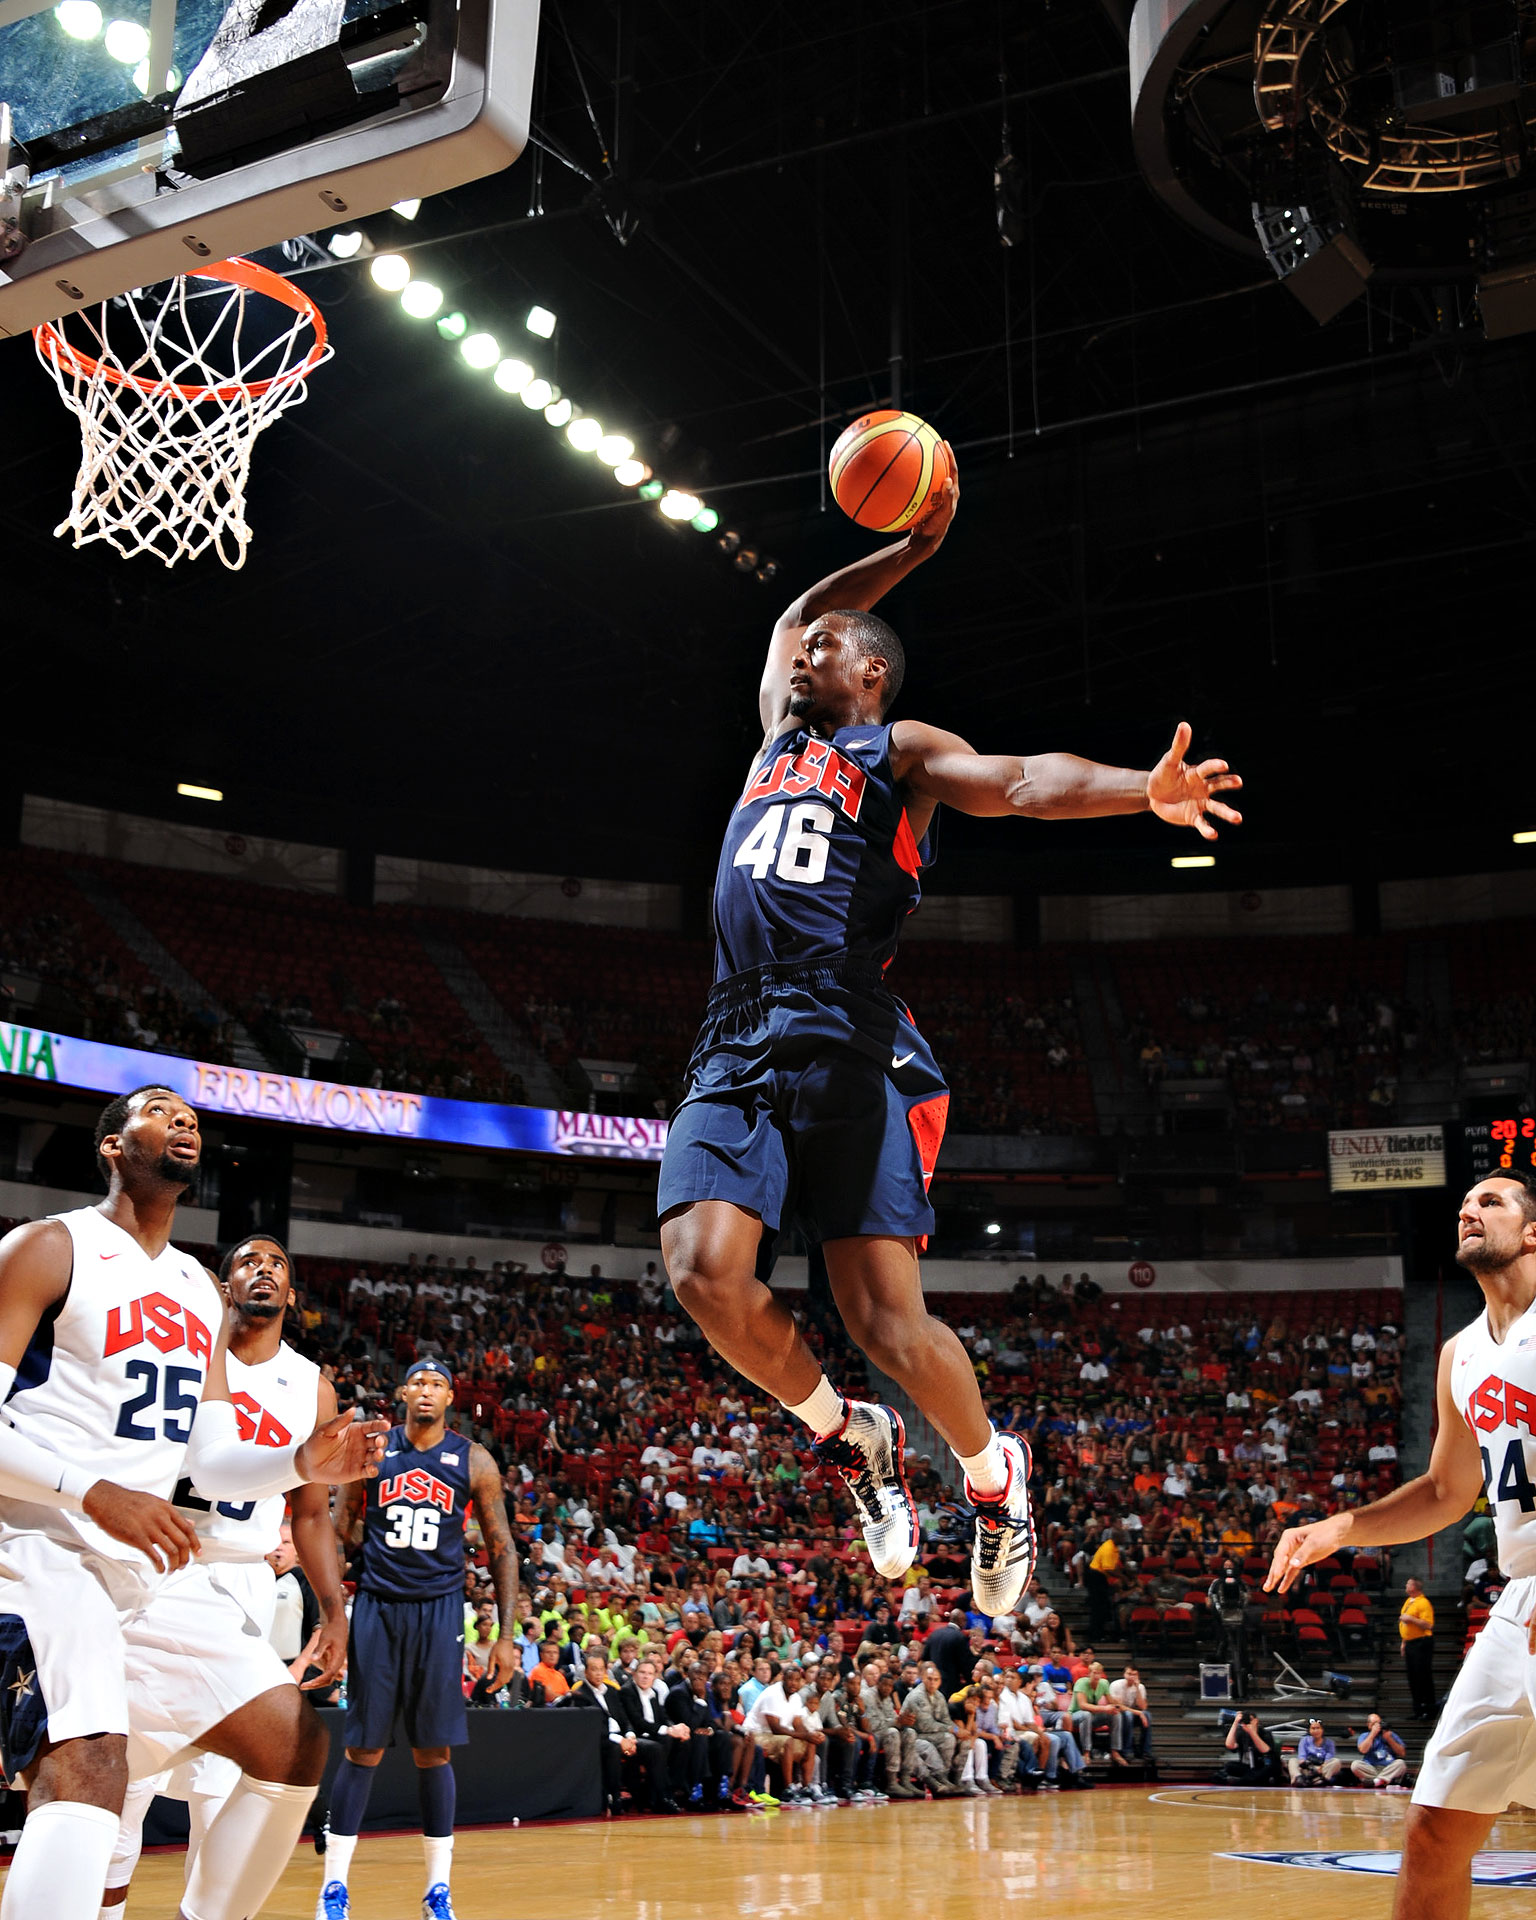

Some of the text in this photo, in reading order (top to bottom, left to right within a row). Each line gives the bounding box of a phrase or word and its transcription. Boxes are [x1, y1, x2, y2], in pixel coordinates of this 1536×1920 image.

[738, 738, 867, 823] USA
[733, 803, 835, 885] 46
[192, 1065, 422, 1135] FREMONT
[1465, 1125, 1488, 1136] PLYR
[1490, 1119, 1518, 1140] 20
[1472, 1139, 1516, 1154] PTS 2
[539, 1166, 579, 1184] 109
[1349, 1156, 1424, 1168] unlvtickets.com
[1350, 1167, 1424, 1182] 739-FANS
[1500, 1153, 1512, 1168] 0
[1132, 1267, 1151, 1282] 110
[103, 1291, 212, 1372] USA
[115, 1359, 202, 1444] 25
[231, 1391, 293, 1448] SA
[378, 1467, 455, 1515] USA
[385, 1505, 441, 1551] 36
